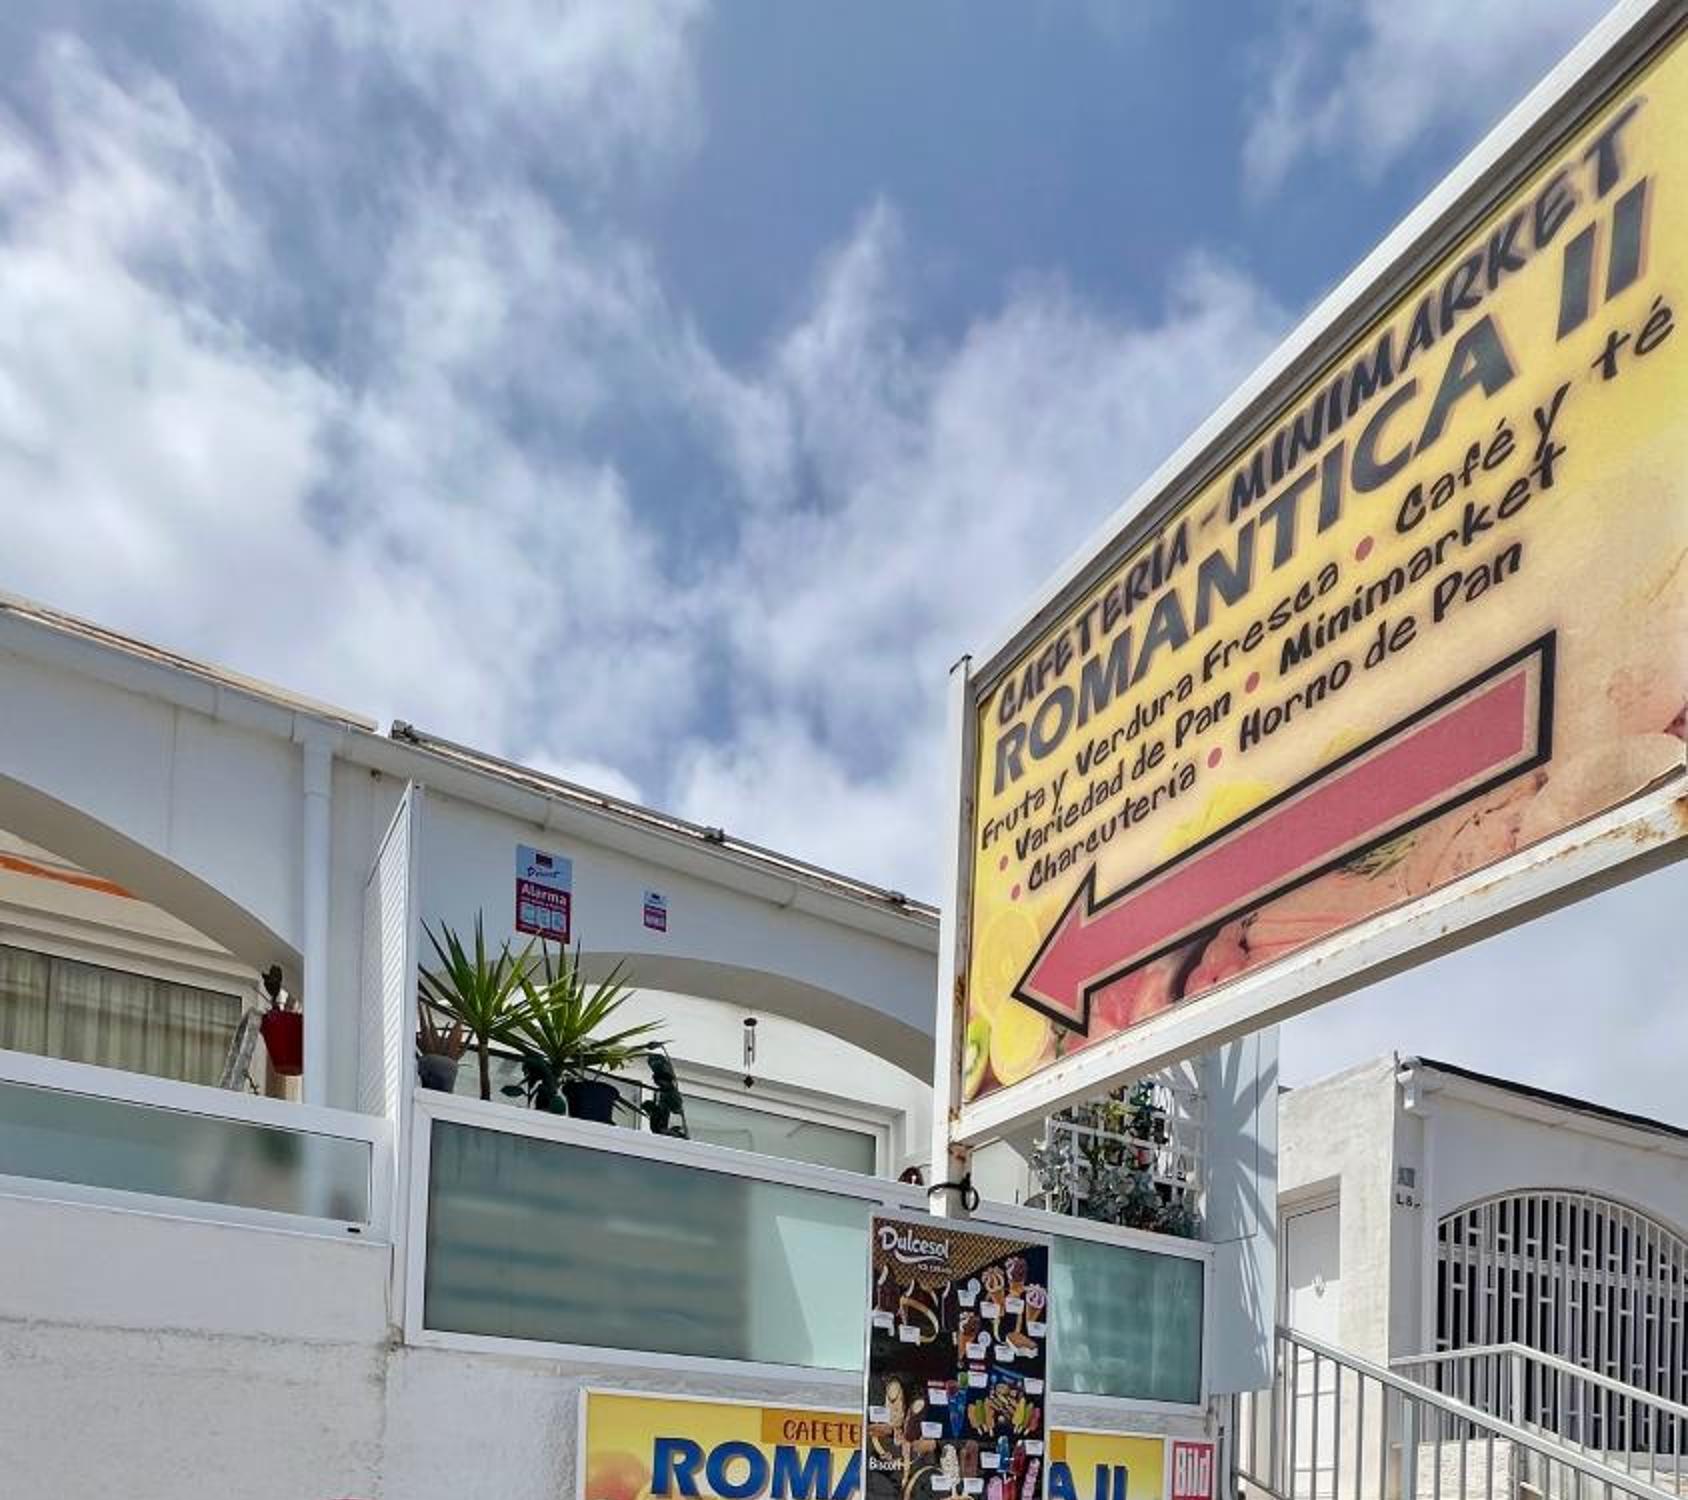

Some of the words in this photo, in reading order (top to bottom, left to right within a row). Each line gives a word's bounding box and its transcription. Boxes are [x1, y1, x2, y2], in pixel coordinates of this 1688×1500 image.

[993, 313, 1516, 796] ROMANTICA
[1556, 174, 1648, 342] II
[1229, 103, 1641, 524] MINIMARKET
[981, 786, 1045, 851] Fruta
[1052, 768, 1068, 815] y
[1075, 673, 1193, 776] Verdura
[1203, 562, 1339, 683] Fresca
[1395, 417, 1515, 533] Café
[1533, 381, 1571, 461] y
[1592, 295, 1674, 380] té
[1015, 758, 1123, 862] Variedad
[1131, 739, 1164, 780] de
[1175, 691, 1231, 749] Pan
[1280, 442, 1566, 676] Minimarket
[1027, 762, 1196, 891] Charcutería
[1239, 660, 1352, 752] Horno
[1364, 615, 1417, 670] de
[1433, 542, 1522, 624] Pan
[521, 883, 567, 906] Alarma
[878, 1226, 949, 1259] Dulcesol
[783, 1418, 861, 1445] CAFETE
[1176, 1446, 1211, 1497] Bild
